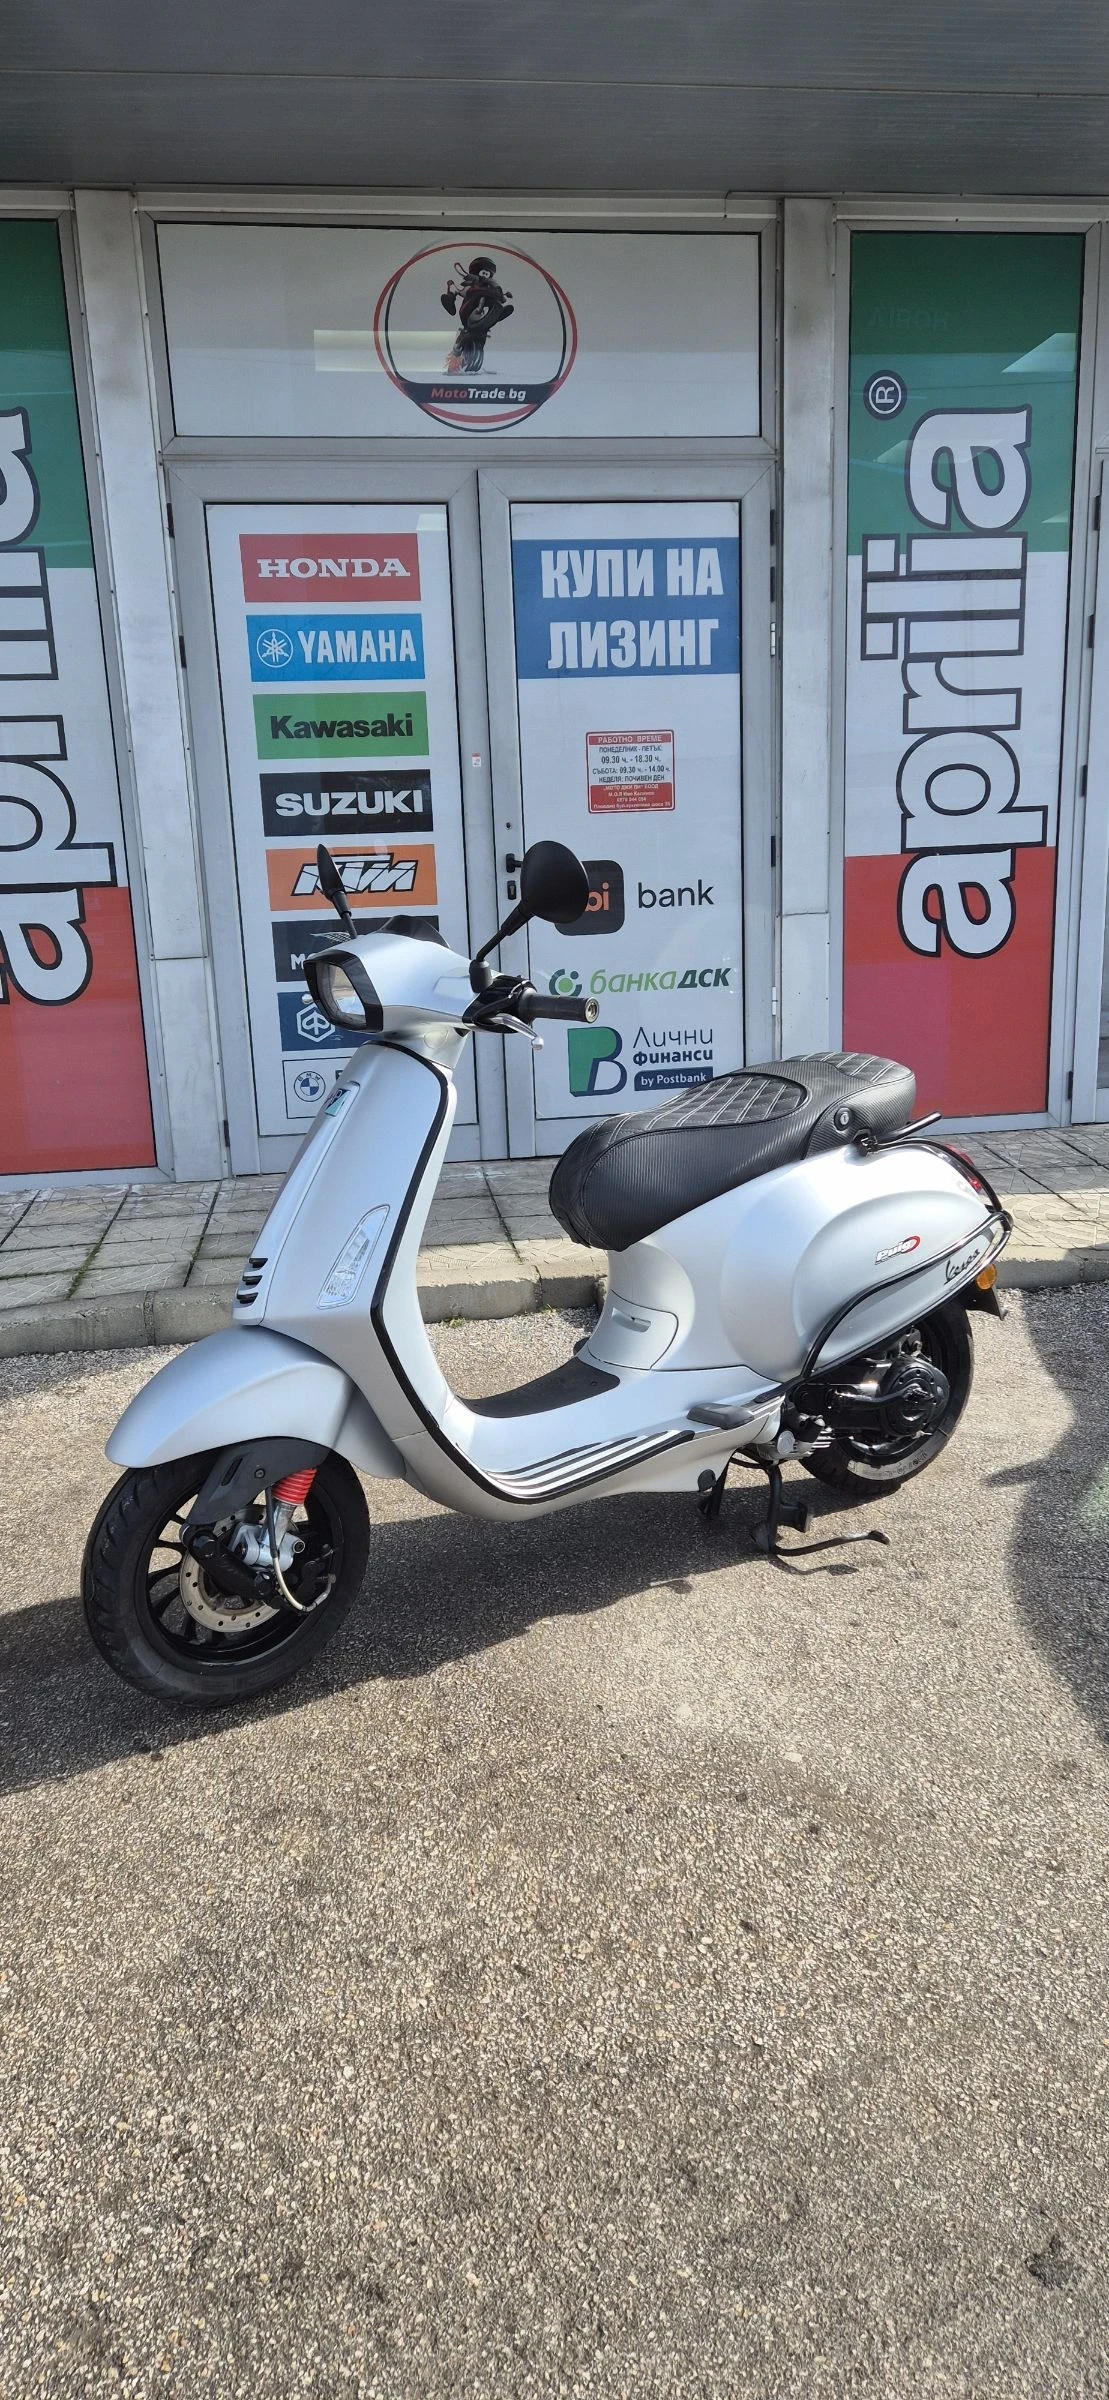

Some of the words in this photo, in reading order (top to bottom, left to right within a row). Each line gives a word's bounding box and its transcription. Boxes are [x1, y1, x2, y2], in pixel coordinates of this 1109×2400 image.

[257, 557, 411, 578] HONDA
[541, 548, 654, 599] КУПИ
[666, 547, 724, 596] НА
[297, 629, 416, 664] YAMAHA
[547, 618, 719, 670] ЛИЗИНГ
[861, 404, 1048, 959] aprilia
[270, 712, 413, 740] Kawasaki
[598, 735, 633, 744] РАБОТНО
[637, 734, 662, 742] ВРЕМЕ
[601, 756, 620, 764] 09.30
[635, 755, 653, 763] 18.30
[275, 789, 424, 817] SUZUKI
[638, 879, 714, 909] bank
[633, 1026, 713, 1049] Лични
[633, 1049, 713, 1067] финанси
[641, 1076, 654, 1088] by
[657, 1072, 707, 1085] Postbank
